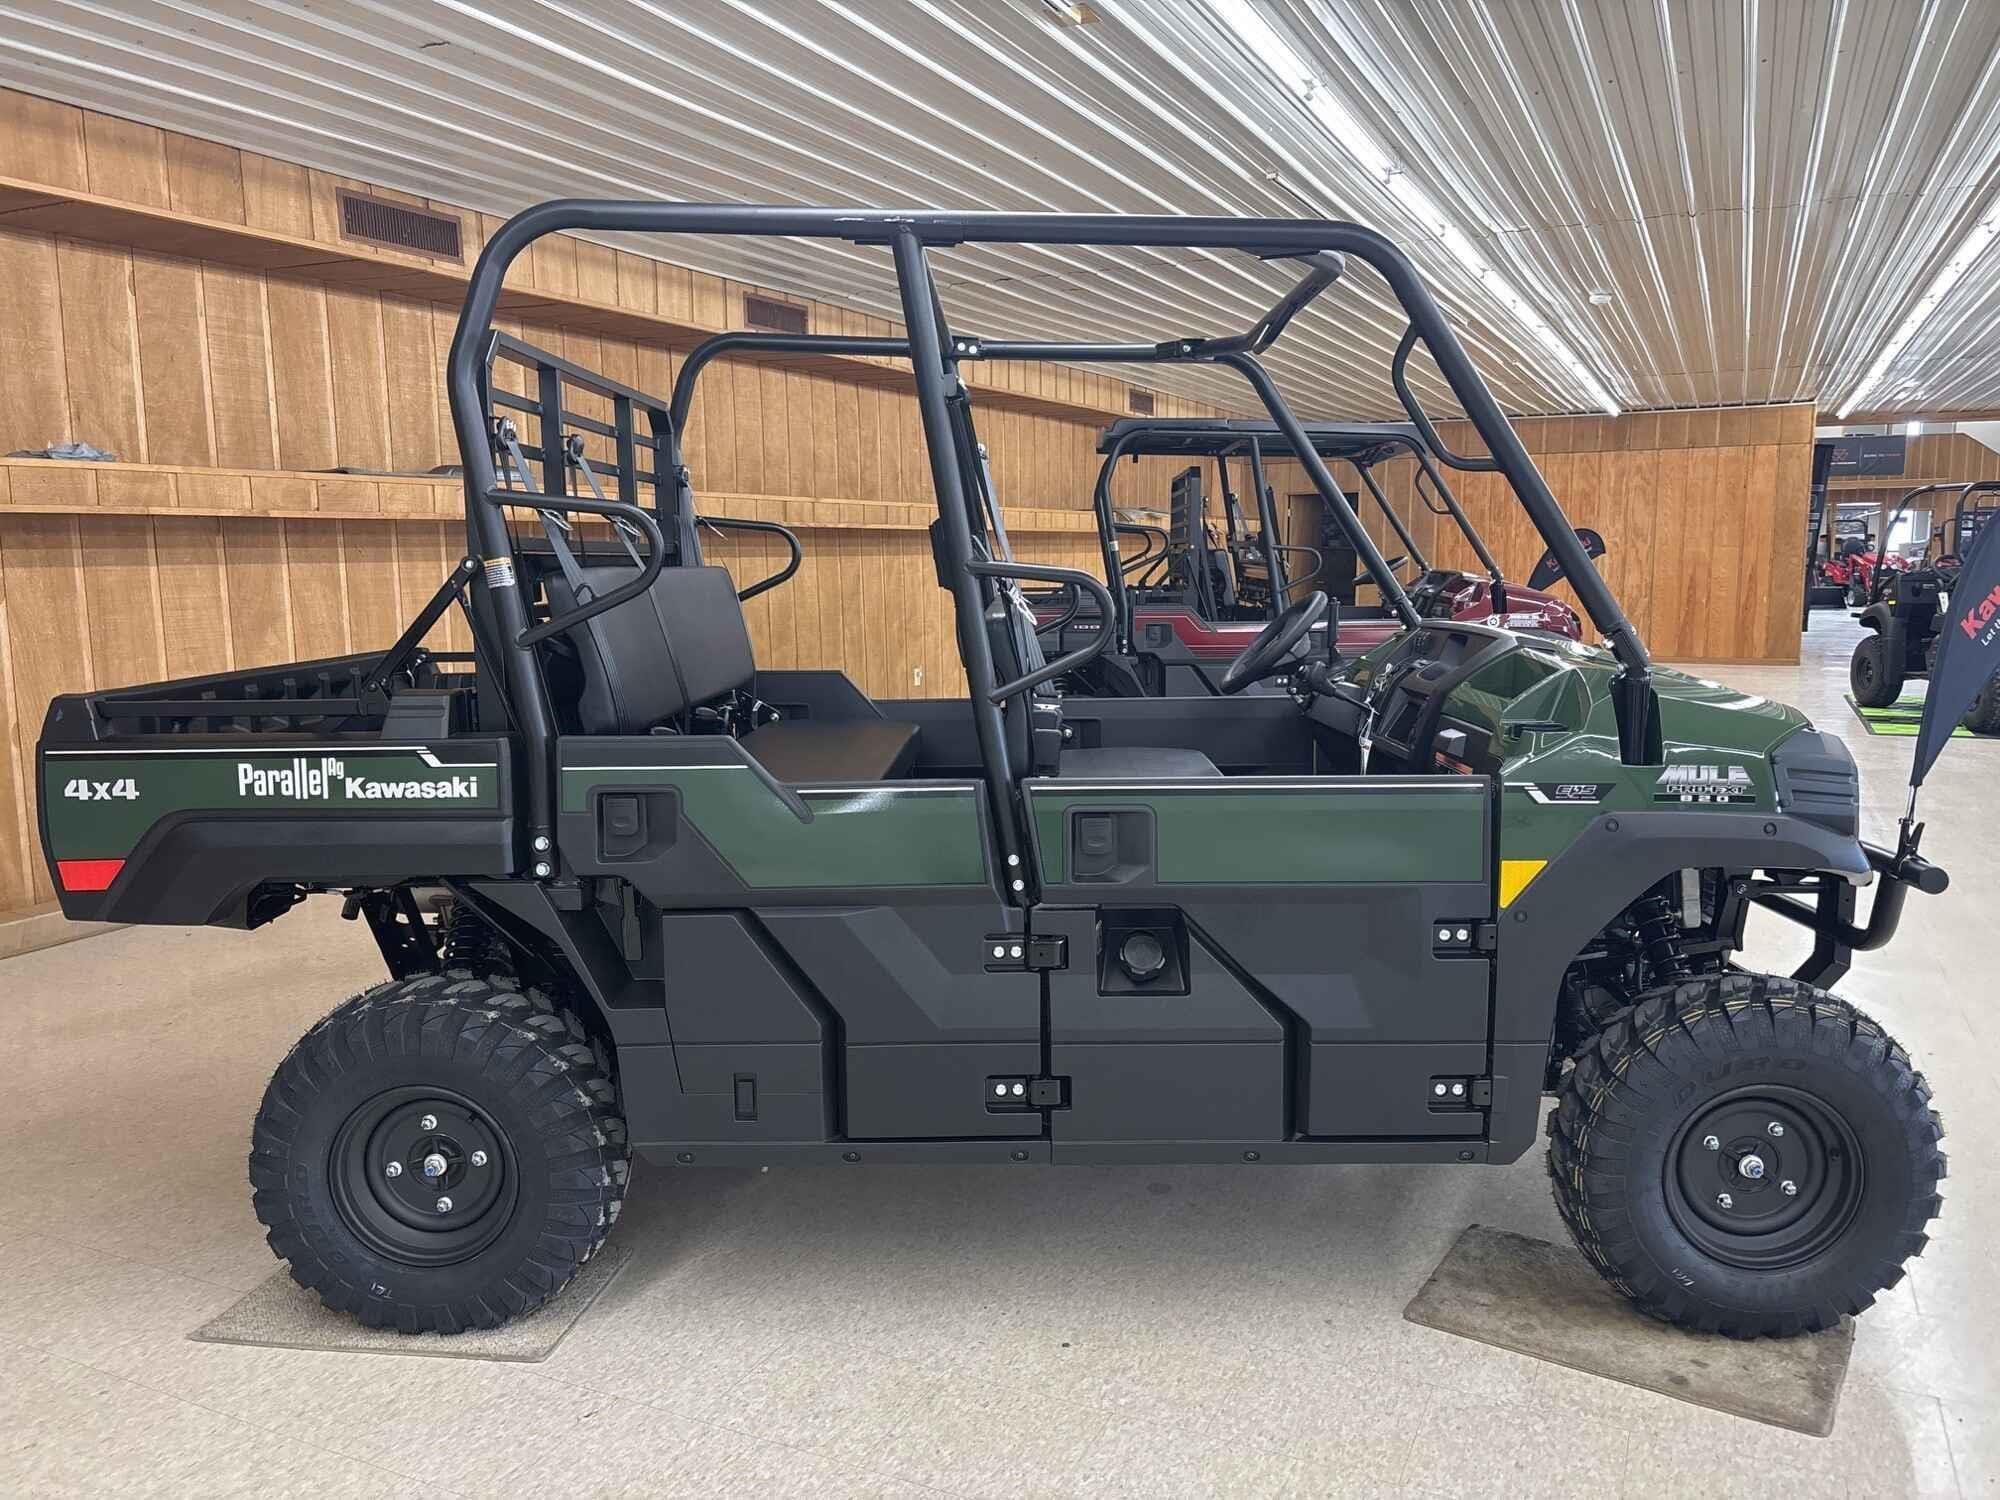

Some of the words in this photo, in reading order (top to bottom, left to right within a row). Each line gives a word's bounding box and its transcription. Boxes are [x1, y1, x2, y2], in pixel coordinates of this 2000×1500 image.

[237, 757, 329, 800] Parallel
[328, 757, 345, 779] Ag
[345, 775, 478, 799] Kawasaki
[1656, 765, 1755, 785] MULE
[64, 779, 140, 800] 4x4
